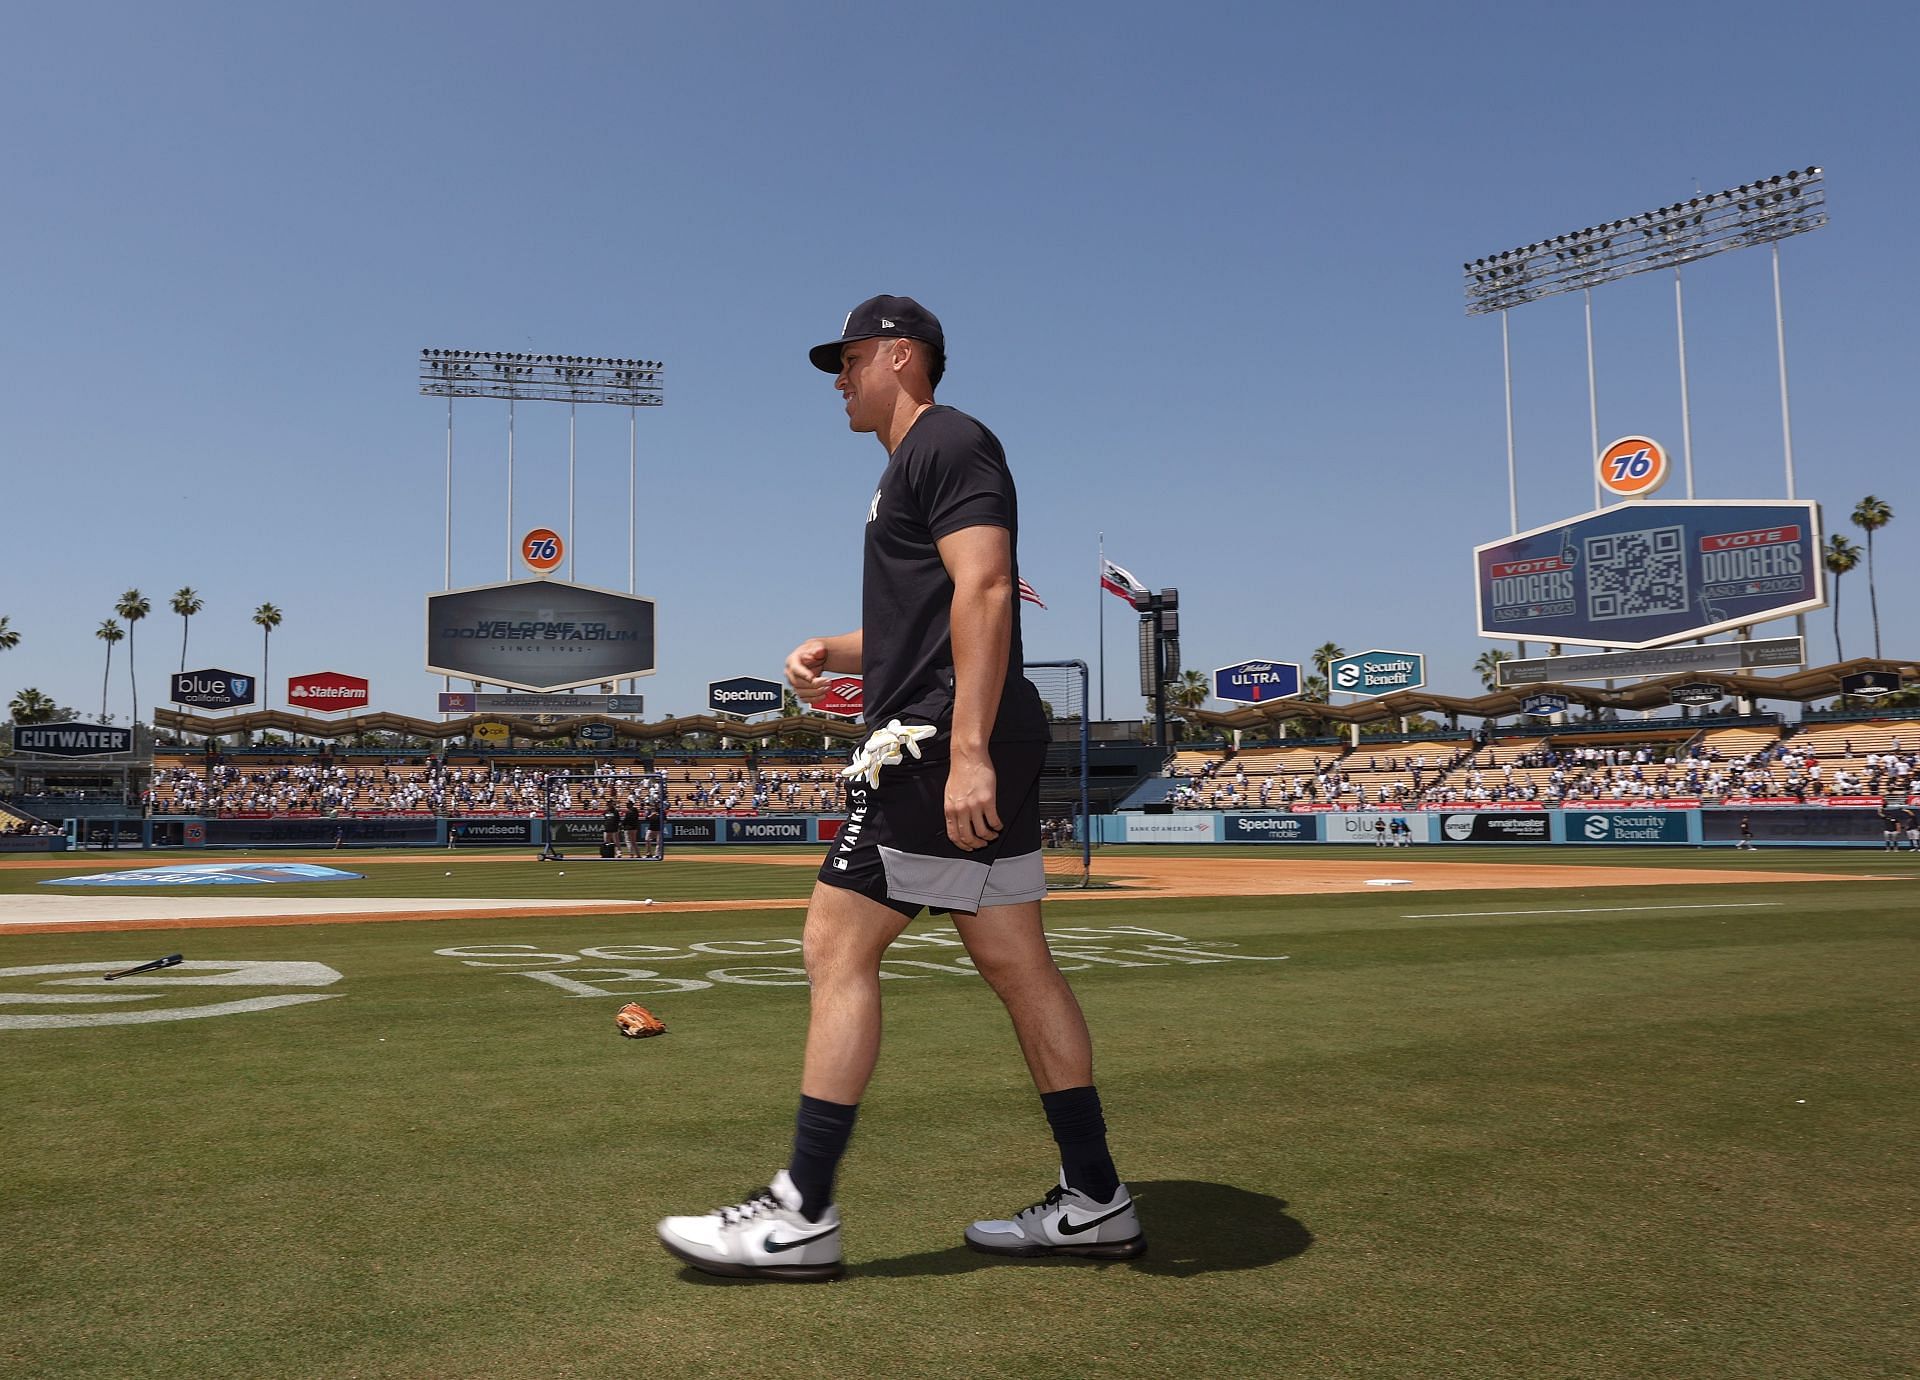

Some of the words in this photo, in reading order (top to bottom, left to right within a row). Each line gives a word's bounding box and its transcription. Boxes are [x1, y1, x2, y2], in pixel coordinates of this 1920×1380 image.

[1609, 448, 1653, 481] 76
[1715, 531, 1783, 546] VOTE
[528, 538, 557, 560] 76
[1504, 560, 1558, 574] VOTE
[1702, 543, 1802, 583] DODGERS
[1492, 571, 1574, 607] DODGERS
[478, 621, 575, 633] WELCOME
[580, 622, 607, 633] TO
[442, 628, 536, 640] DODGER
[543, 630, 639, 641] STADIUM
[1363, 659, 1414, 675] Security
[178, 675, 226, 695] blue
[1232, 672, 1280, 685] ULTRA
[1364, 673, 1409, 686] Benefit
[185, 693, 231, 703] california
[713, 688, 775, 703] Spectrum
[20, 730, 124, 749] CUTWATER
[467, 824, 526, 834] vividseats
[1238, 818, 1297, 832] Spectrum
[1345, 817, 1375, 832] blu
[1487, 819, 1546, 827] smartwater
[1613, 815, 1666, 829] Security
[674, 825, 709, 836] Health
[745, 825, 801, 836] MORTON
[1268, 830, 1298, 839] mobile
[1614, 827, 1660, 839] Benefit
